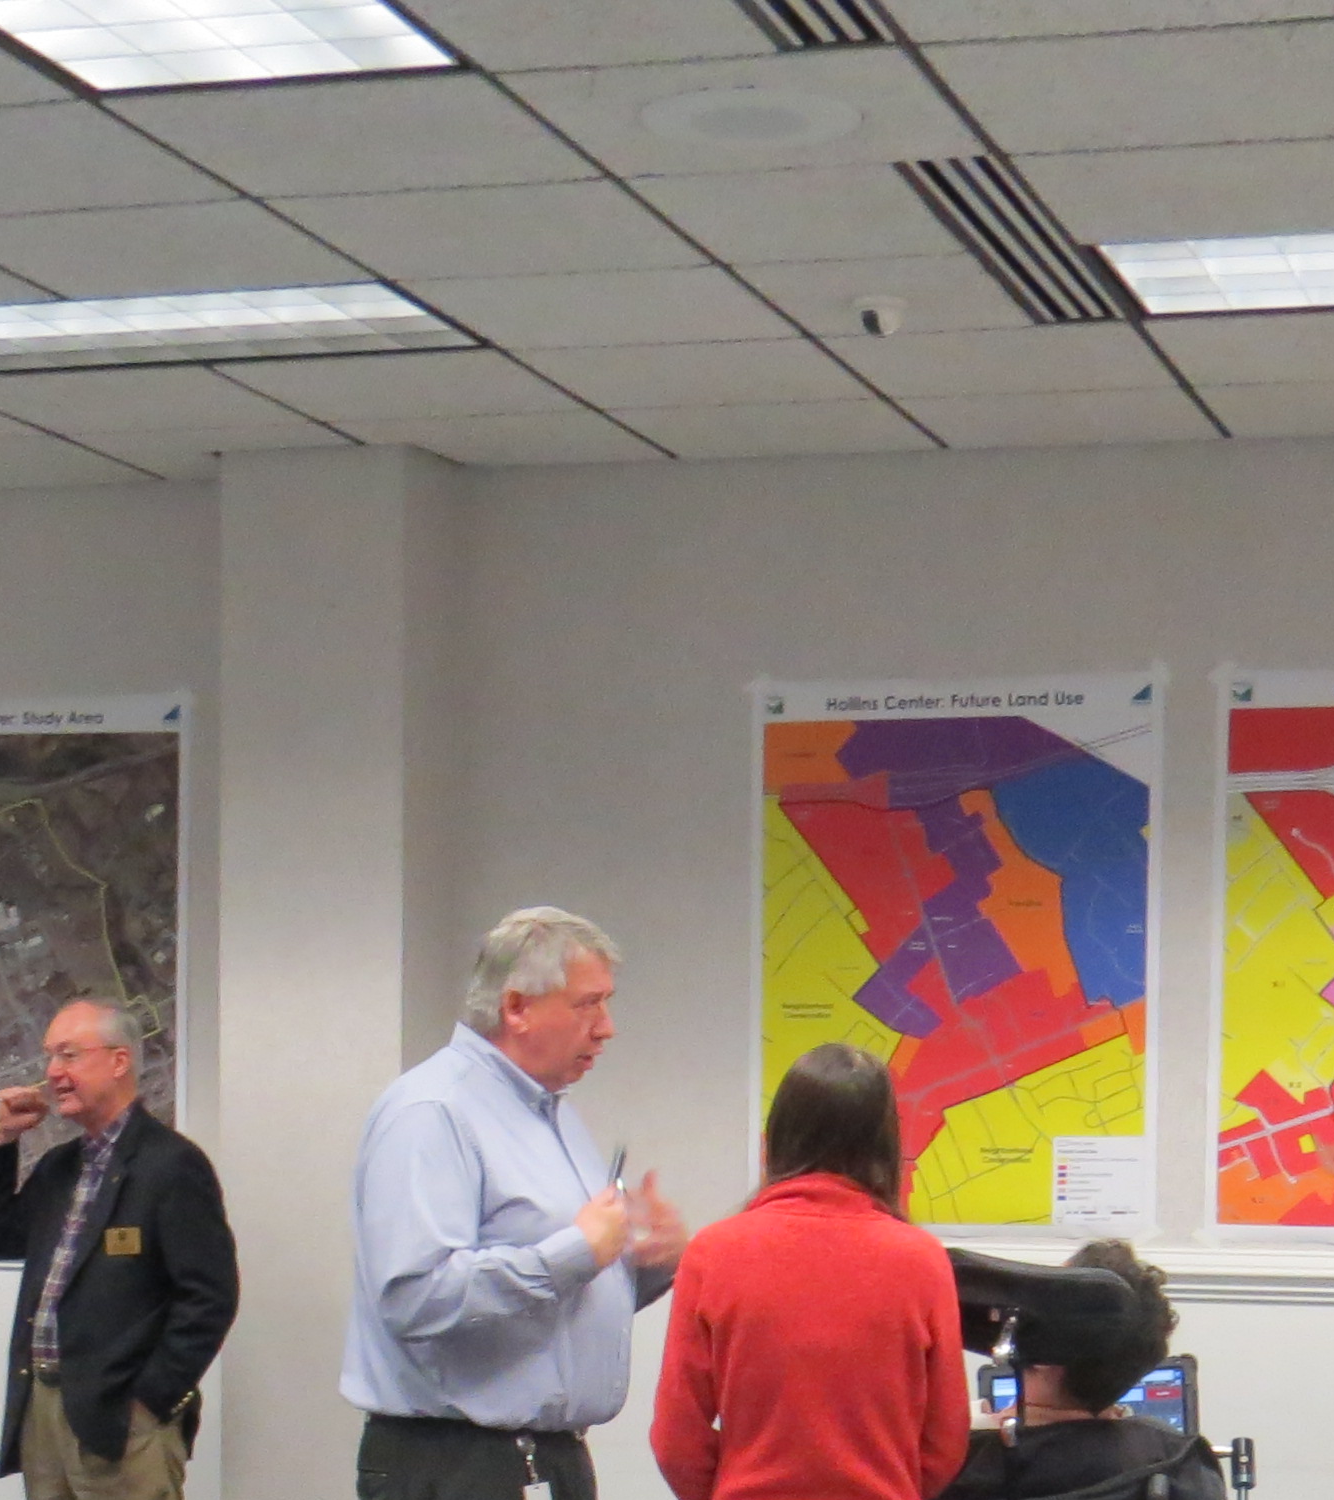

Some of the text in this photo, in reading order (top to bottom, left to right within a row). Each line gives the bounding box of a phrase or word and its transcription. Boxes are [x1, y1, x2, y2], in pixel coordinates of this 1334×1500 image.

[825, 697, 879, 712] Hollins
[951, 693, 1004, 708] Future
[1008, 692, 1049, 707] Land
[1054, 690, 1085, 706] Use
[22, 711, 65, 727] Study
[68, 710, 105, 725] Area
